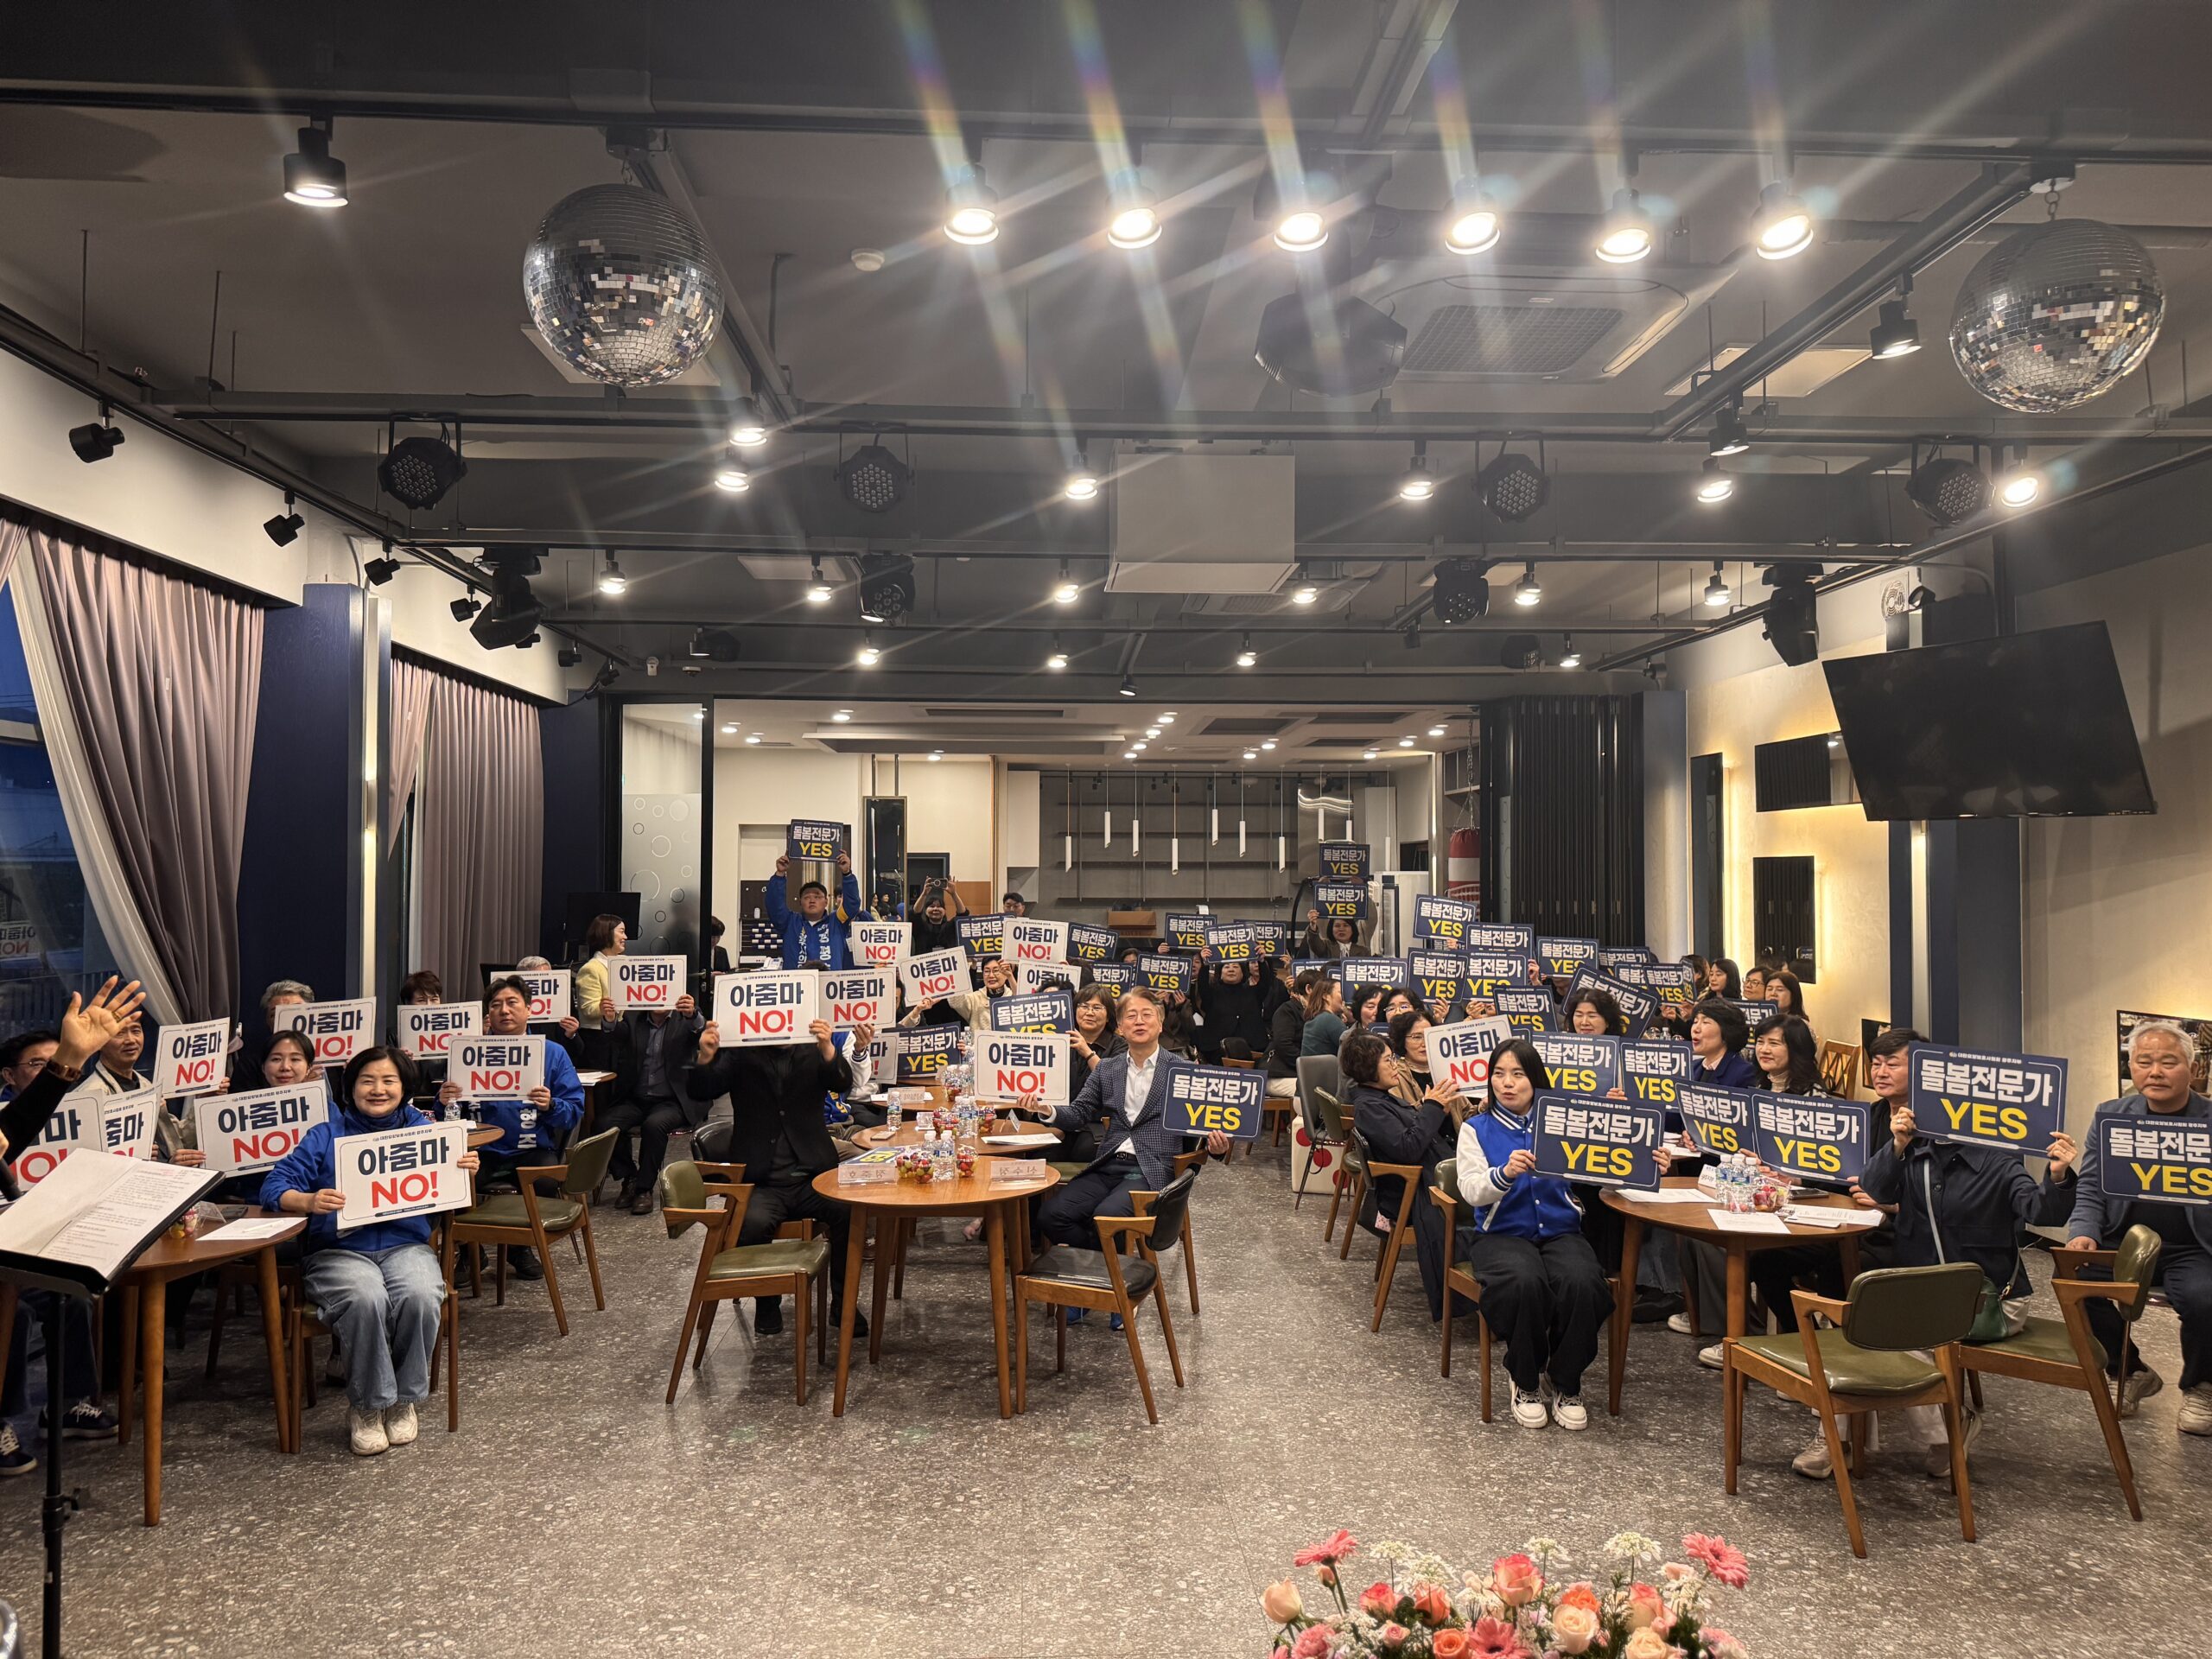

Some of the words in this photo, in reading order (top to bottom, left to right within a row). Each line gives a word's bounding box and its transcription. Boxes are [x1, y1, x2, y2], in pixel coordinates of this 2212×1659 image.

[793, 823, 840, 842] 돌봄전문가
[801, 843, 832, 857] YES
[1324, 849, 1365, 864] 돌봄전문가
[1331, 862, 1359, 875] YES
[1319, 888, 1363, 901] 돌봄전문가
[1327, 904, 1355, 915] YES
[1421, 902, 1471, 922] 돌봄전문가
[861, 929, 902, 944] 아줌마
[961, 919, 1002, 938] 돌봄전문
[1014, 926, 1058, 944] 아줌마
[1072, 928, 1114, 949] 돌봄전문가
[1208, 928, 1255, 945] 돌봄전문가
[1256, 926, 1282, 938] 전문가
[1430, 920, 1462, 938] YES
[1178, 934, 1205, 947] YES
[1471, 930, 1528, 949] 돌봄전문가
[866, 945, 896, 960] NO!
[1018, 944, 1051, 960] NO!
[1078, 944, 1104, 959] YES
[1219, 944, 1249, 957] YES
[1541, 944, 1594, 961] 돌봄전문가
[620, 964, 675, 982] 아줌마
[911, 957, 957, 981] 아줌마
[1093, 969, 1128, 982] 봄전문가
[1141, 958, 1189, 975] 돌봄전문가
[1346, 965, 1403, 982] 돌봄전문가
[1414, 957, 1465, 978] 돌봄전문가
[1469, 958, 1522, 977] 봄전문가
[826, 978, 885, 1000] 아줌마
[919, 975, 955, 995] NO!
[1149, 975, 1179, 988] YES
[1423, 980, 1456, 999] YES
[1468, 979, 1510, 995] YE
[626, 984, 667, 1002] NO!
[730, 982, 804, 1007] 아줌마
[1497, 994, 1549, 1012] 돌봄전문가
[1657, 988, 1683, 1001] YES
[531, 998, 551, 1015] O!
[834, 1001, 877, 1022] NO!
[997, 1001, 1066, 1024] 돌봄전문가
[1745, 1008, 1772, 1025] 전문가
[292, 1010, 363, 1033] 아줌마
[410, 1012, 470, 1031] 아줌마
[740, 1009, 793, 1034] NO!
[173, 1031, 221, 1058] 아줌마
[898, 1032, 958, 1054] 돌봄전문가
[1440, 1028, 1500, 1058] 아줌마
[463, 1046, 531, 1066] 아줌마
[908, 1053, 948, 1071] YES
[989, 1043, 1055, 1067] 아줌마
[1535, 1042, 1611, 1067] 돌봄전문가
[1625, 1050, 1686, 1076] 돌봄전문가
[175, 1058, 215, 1085] NO!
[471, 1071, 520, 1090] NO!
[1450, 1059, 1490, 1085] NO
[1545, 1067, 1597, 1091] YES
[997, 1070, 1046, 1094] NO!
[1173, 1074, 1258, 1105] 돌봄전문가
[1635, 1077, 1675, 1102] YES
[1921, 1058, 2053, 1107] 돌봄전문가
[219, 1095, 311, 1133] 아줌마
[1185, 1103, 1241, 1131] YES
[1680, 1090, 1748, 1127] 돌봄전문가
[106, 1111, 143, 1147] 줌마
[1545, 1104, 1655, 1147] 돌봄전문가
[1758, 1102, 1859, 1144] 돌봄전문가
[1942, 1099, 2027, 1140] YES
[233, 1128, 299, 1162] NO!
[1695, 1120, 1738, 1152] YES
[359, 1136, 449, 1175] 아줌마
[1775, 1137, 1840, 1173] YES
[2109, 1128, 2211, 1166] 돌봄전문
[1562, 1141, 1632, 1175] YES
[372, 1171, 439, 1208] NO!
[2132, 1163, 2212, 1196] YES
